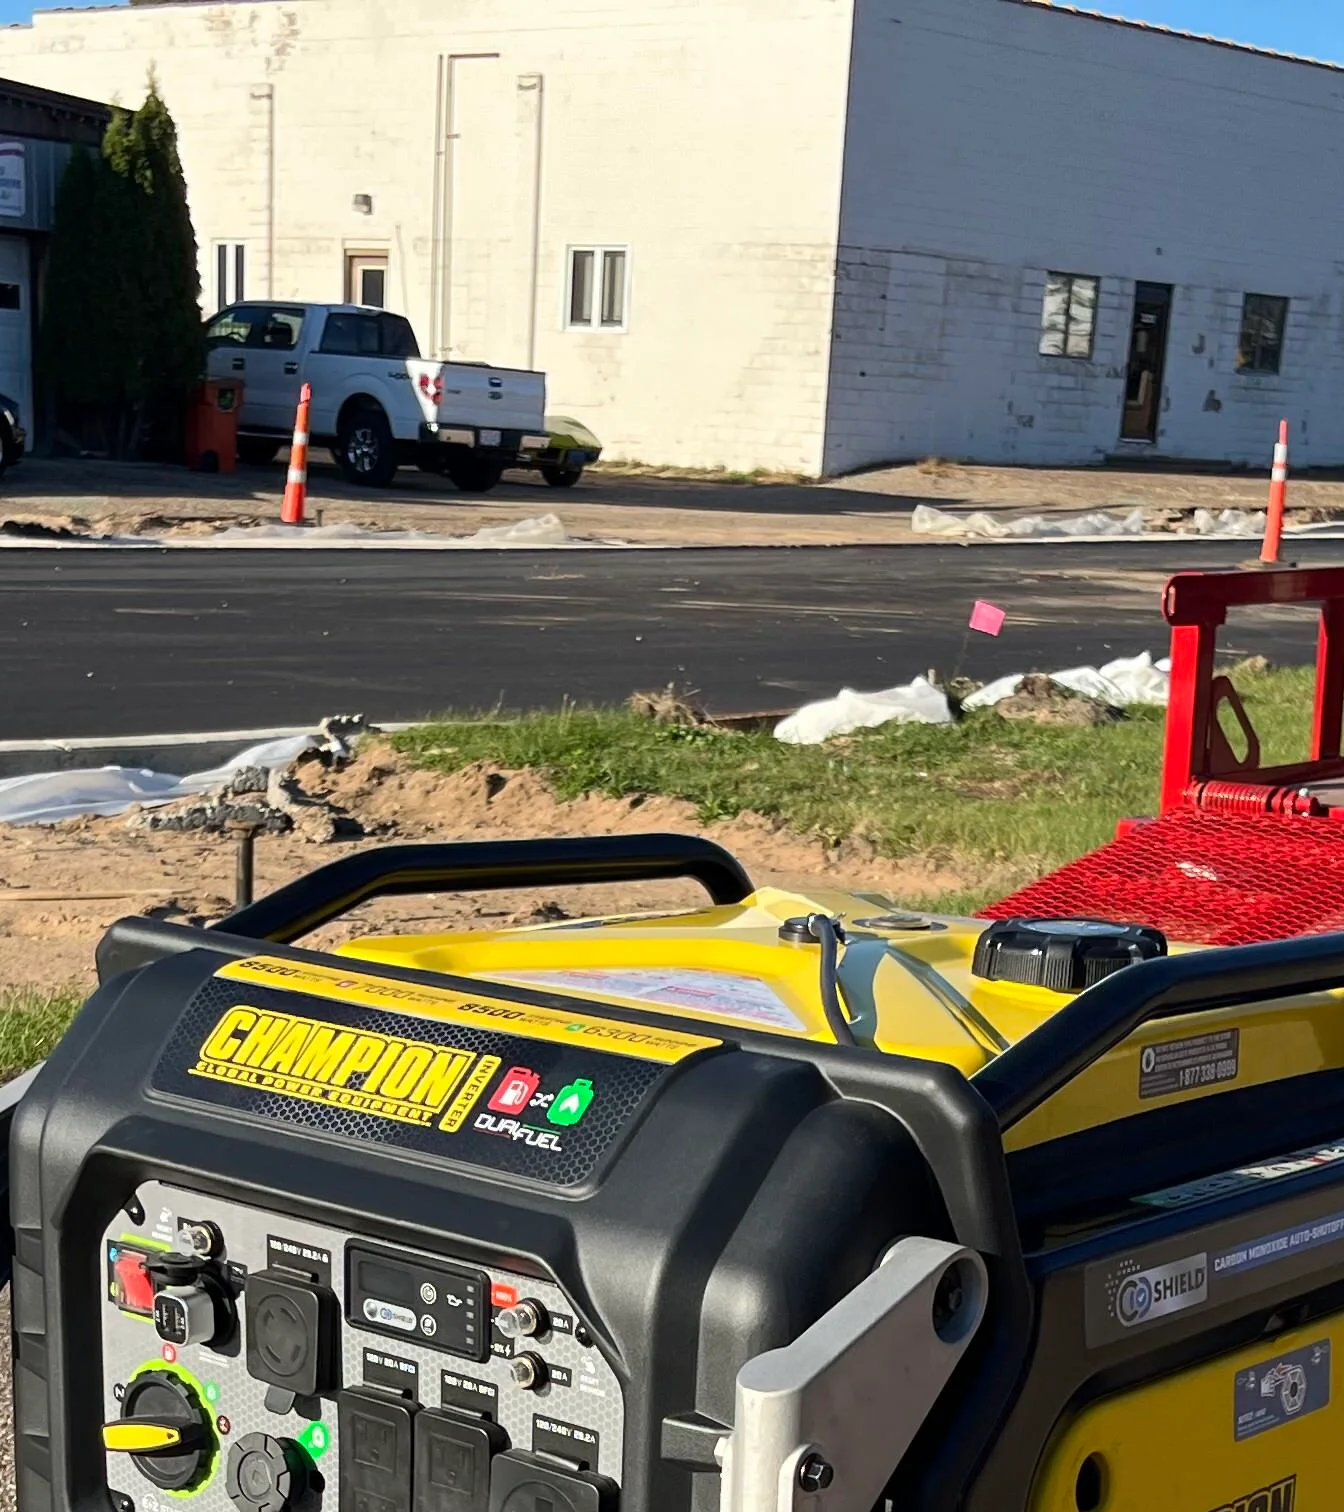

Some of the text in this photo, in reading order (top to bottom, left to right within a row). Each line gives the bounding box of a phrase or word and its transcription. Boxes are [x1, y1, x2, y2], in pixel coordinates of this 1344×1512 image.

[240, 960, 299, 977] 8500
[457, 1002, 526, 1021] 8500
[584, 1026, 653, 1044] 6300
[204, 1009, 470, 1108] CHAMPION
[197, 1062, 433, 1122] GLOBAL POWER EQUIPMENT
[446, 1058, 495, 1128] INVERTER
[1214, 1253, 1248, 1272] CARBON
[1248, 1237, 1289, 1261] MONOXIDE
[1153, 1268, 1205, 1304] SHIELD
